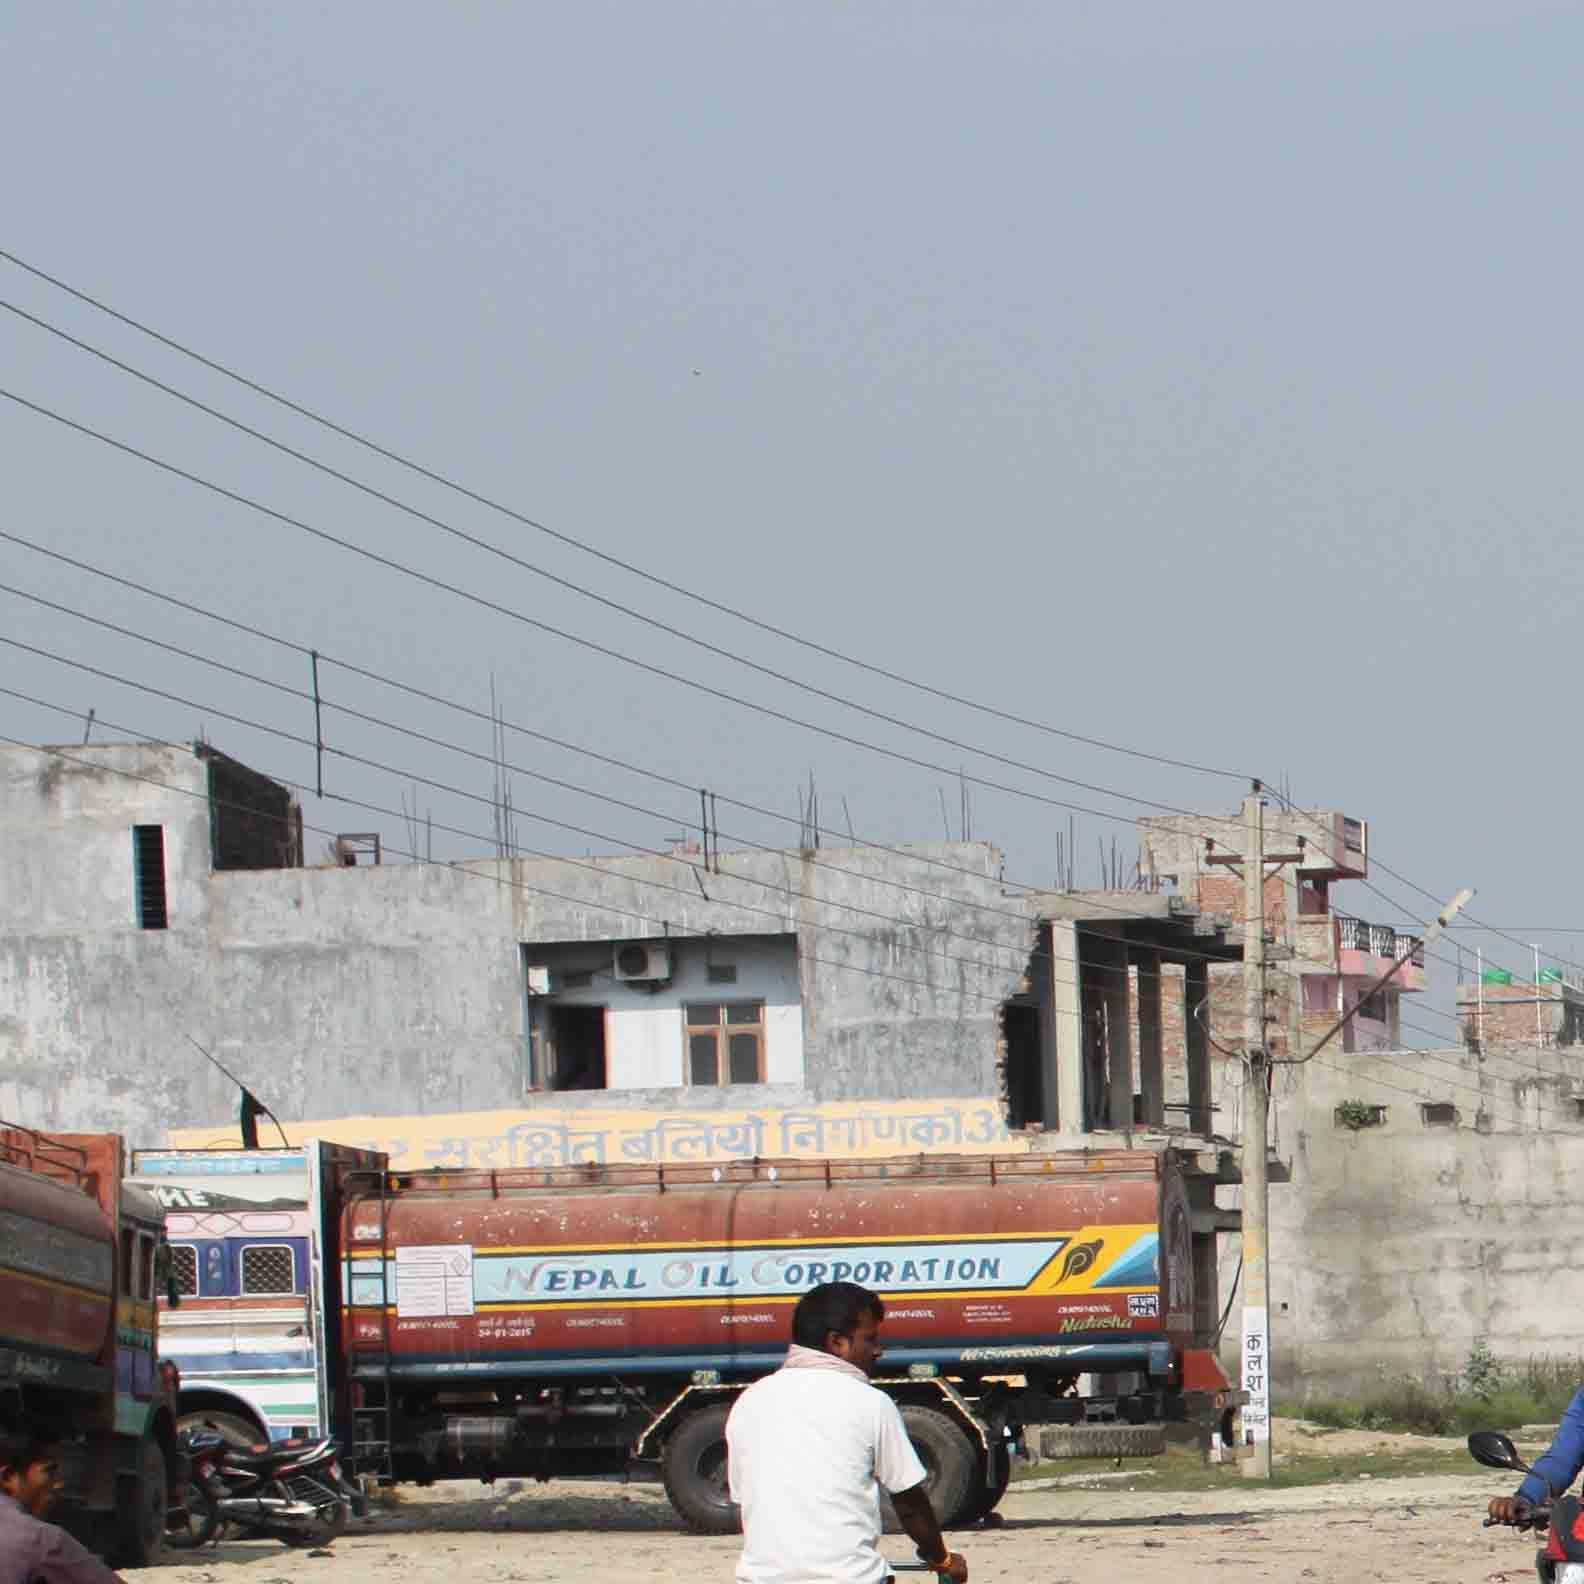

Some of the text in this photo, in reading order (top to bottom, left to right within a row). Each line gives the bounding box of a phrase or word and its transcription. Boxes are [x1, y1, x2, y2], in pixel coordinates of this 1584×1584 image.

[490, 1259, 647, 1296] NEPAL
[661, 1257, 739, 1289] OIL
[751, 1254, 1001, 1287] CORPORATION
